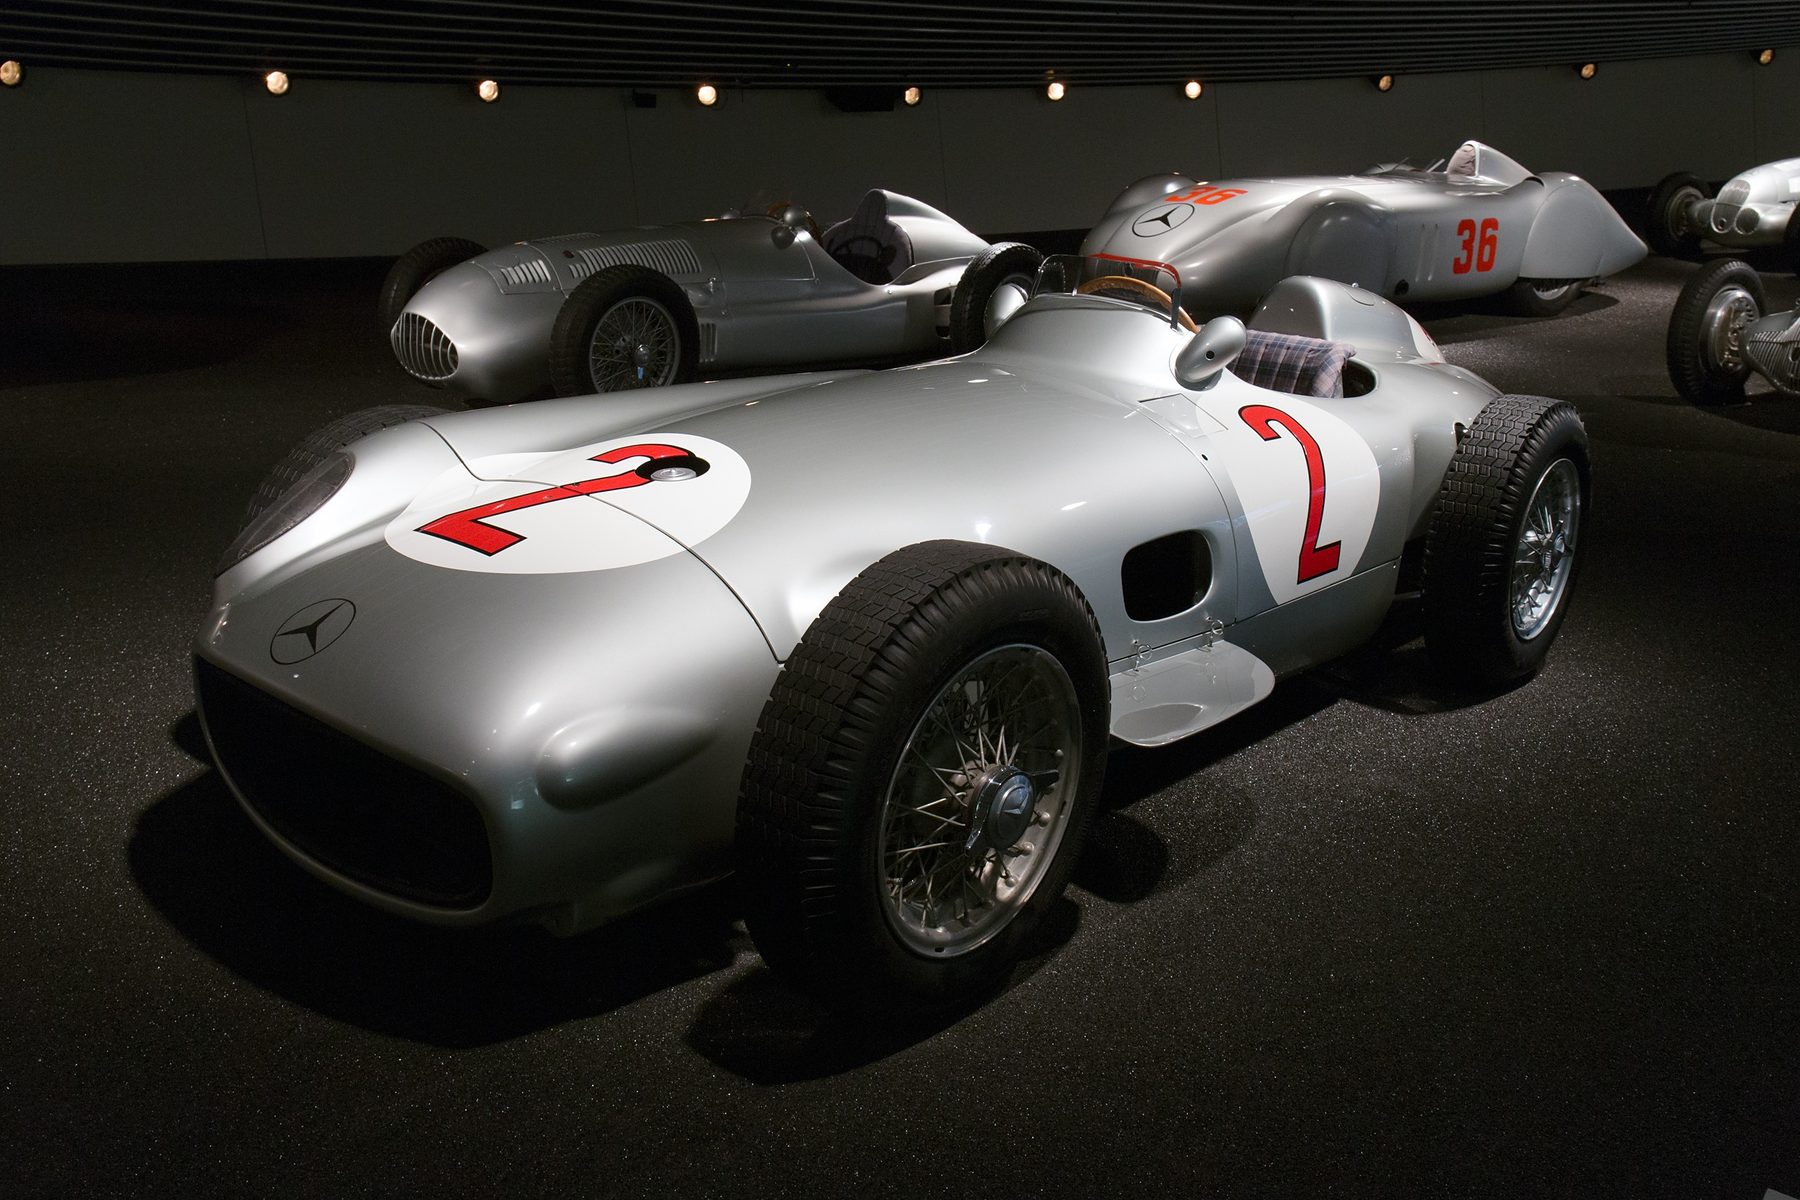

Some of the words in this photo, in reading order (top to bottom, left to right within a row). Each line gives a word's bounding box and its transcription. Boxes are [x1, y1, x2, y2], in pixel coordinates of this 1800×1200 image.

[1164, 186, 1248, 205] 36
[1453, 218, 1500, 274] 36
[414, 443, 698, 557] 2
[1239, 404, 1341, 585] 2
